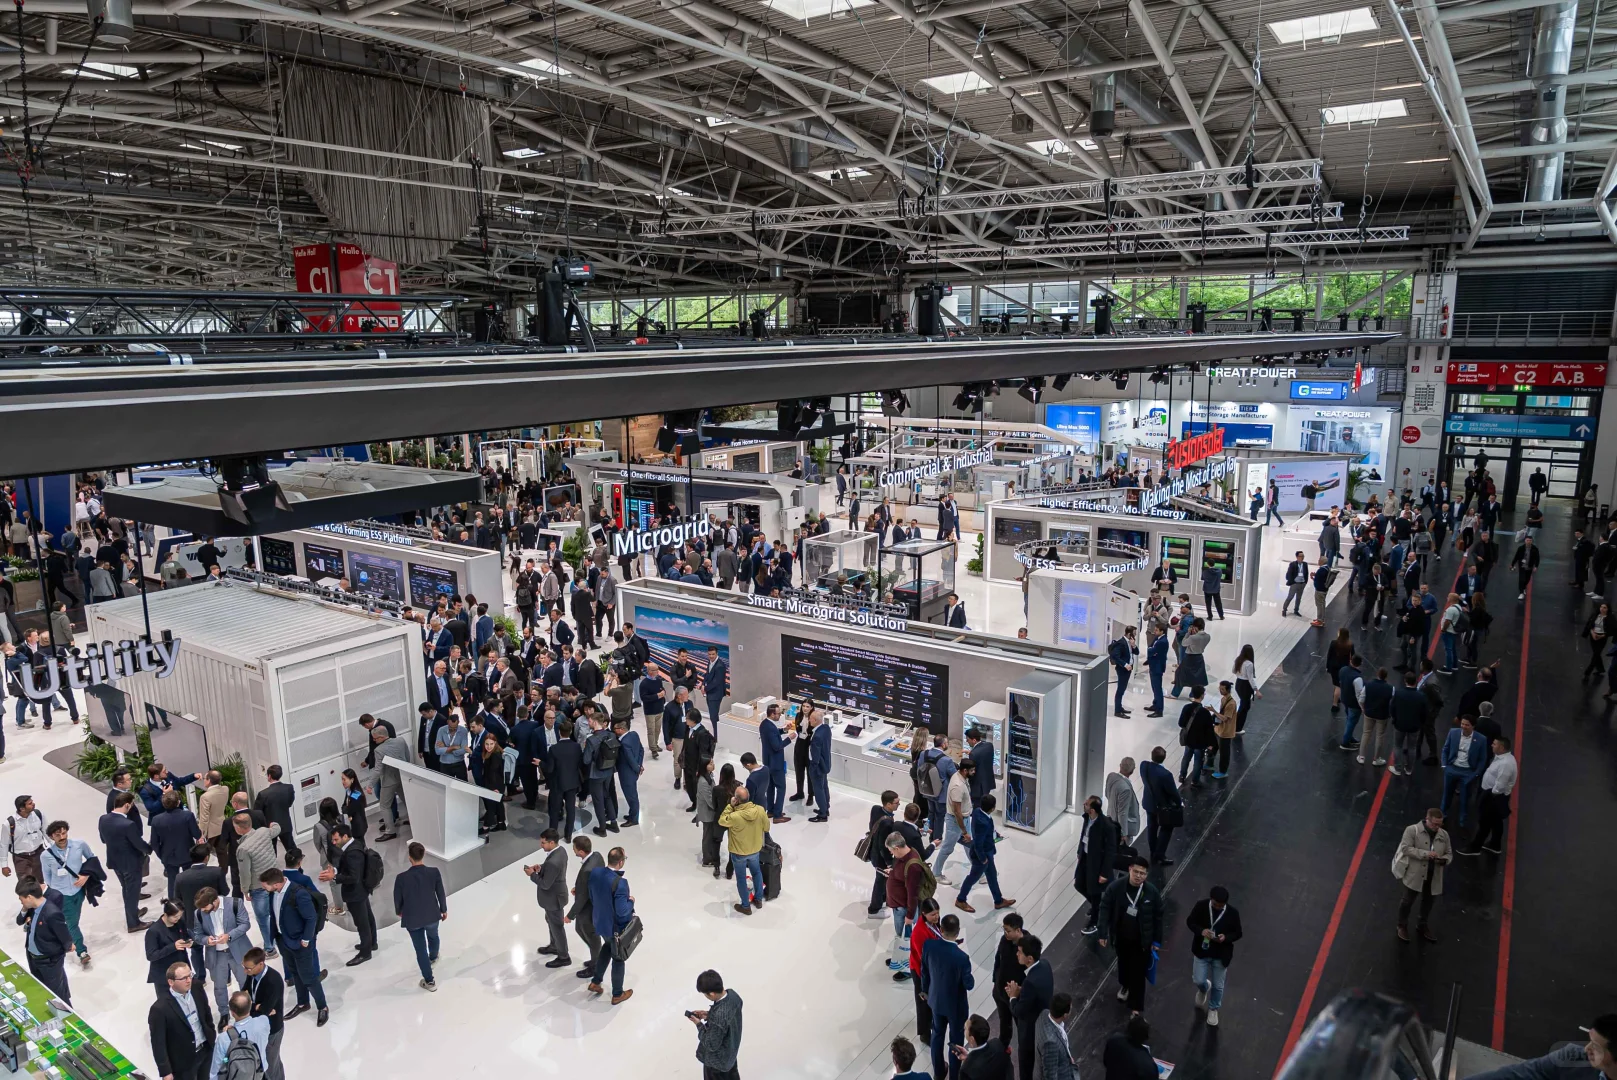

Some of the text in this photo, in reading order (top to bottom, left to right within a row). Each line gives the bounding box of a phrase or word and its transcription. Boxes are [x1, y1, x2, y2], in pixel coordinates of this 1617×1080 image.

[340, 246, 361, 256] Halle
[309, 266, 331, 294] C1
[363, 266, 397, 296] C1
[1206, 367, 1297, 379] GREAT POWER
[1514, 371, 1537, 383] C2
[1552, 371, 1585, 385] A,B
[1314, 410, 1342, 418] GREAT
[1449, 422, 1463, 431] C2
[879, 445, 994, 488] Commercial & Industrial
[1141, 456, 1237, 514] Making the Most of Every Ray
[1039, 497, 1187, 521] Higher Efficiency, Moe Energy
[344, 523, 369, 540] Forming
[370, 530, 382, 540] ESS
[382, 532, 412, 546] Platform
[614, 512, 709, 557] Microgrid
[1035, 559, 1056, 571] ESS
[1101, 561, 1135, 573] Smart
[747, 593, 907, 632] Smart Microgrid Solution
[20, 637, 182, 700] Utility
